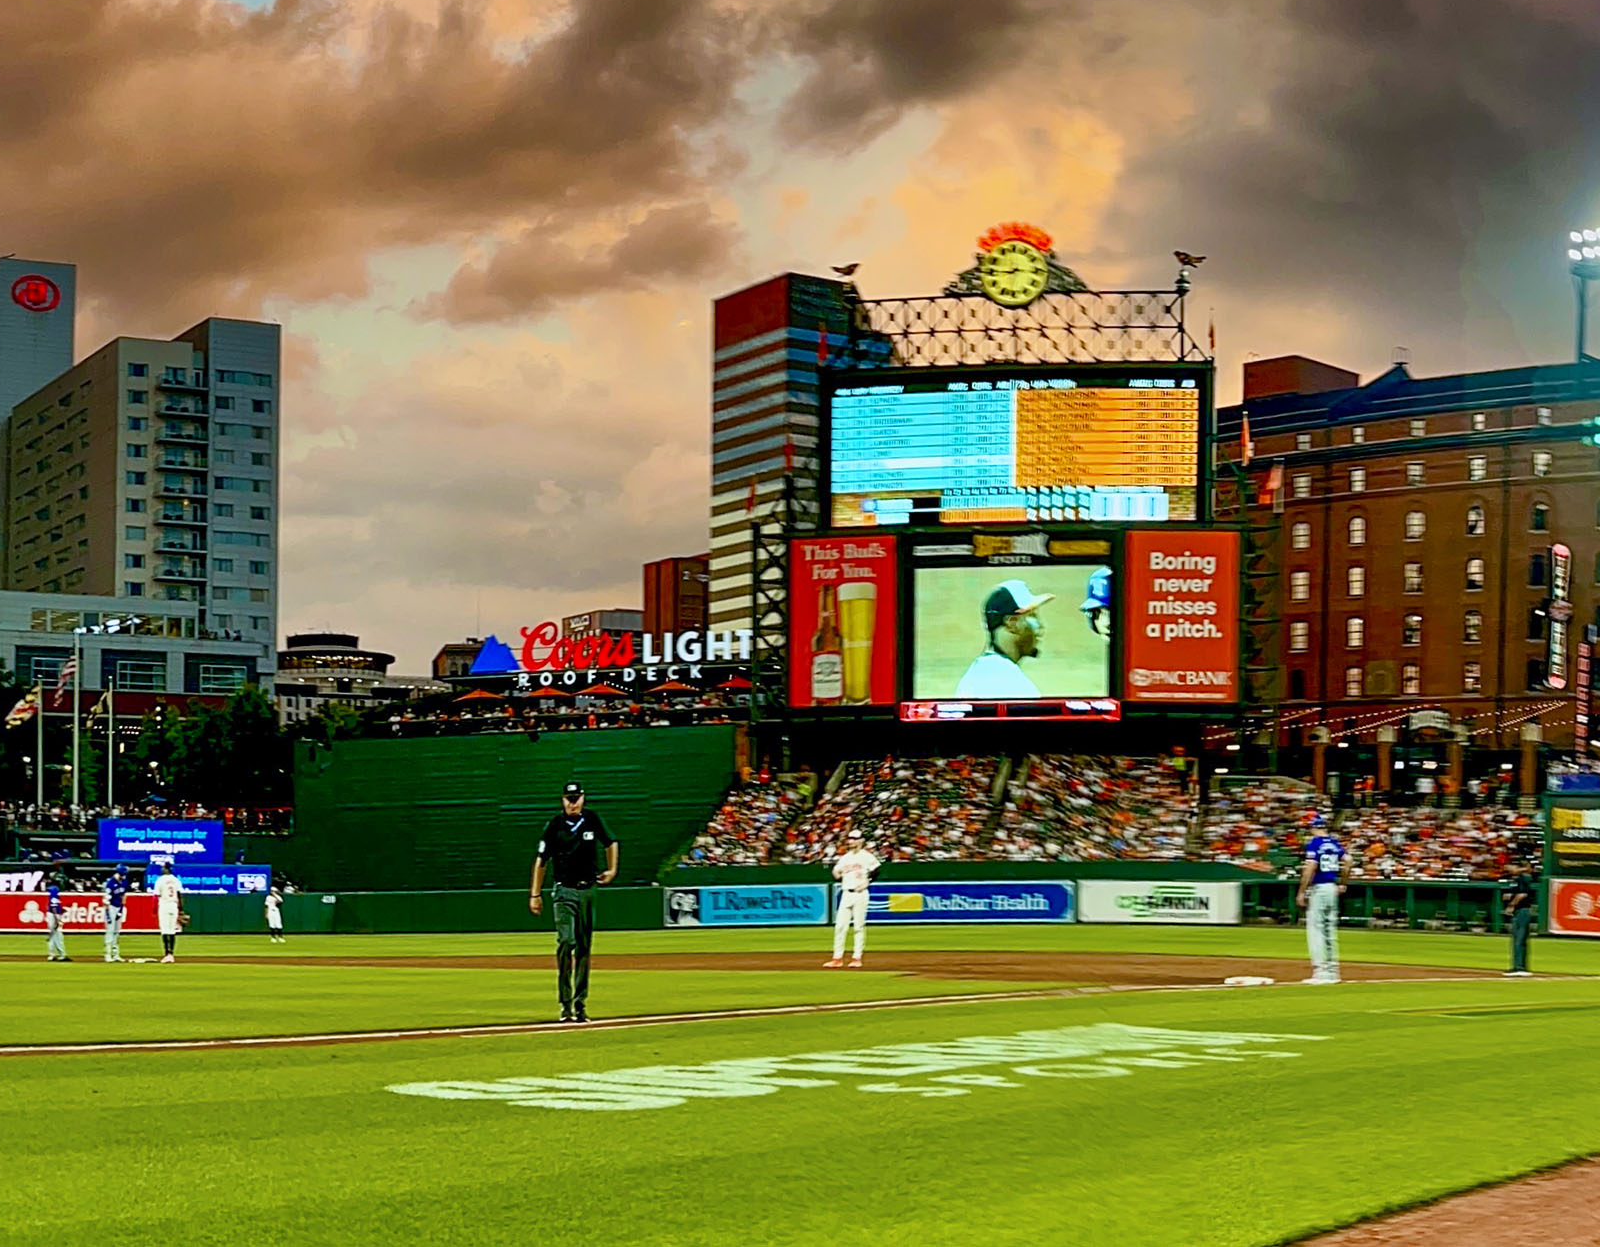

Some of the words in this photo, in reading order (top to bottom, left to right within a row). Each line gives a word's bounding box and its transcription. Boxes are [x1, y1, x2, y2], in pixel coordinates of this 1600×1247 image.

[803, 544, 839, 561] This
[844, 543, 886, 559] Bud's
[812, 564, 838, 580] For
[842, 563, 877, 579] You.
[1150, 552, 1216, 575] Boring
[1154, 578, 1212, 593] never
[1148, 596, 1217, 615] misses
[1146, 622, 1161, 638] a
[1164, 619, 1223, 642] pitch.
[520, 621, 637, 672] Coors
[642, 629, 753, 664] LIGHT
[518, 669, 598, 688] ROOF
[623, 664, 703, 681] DECK
[115, 828, 146, 841] Hitting
[147, 828, 172, 840] home
[173, 830, 193, 840] runs
[194, 828, 207, 840] for
[118, 840, 173, 853] hardworking
[174, 841, 207, 853] people.
[924, 893, 990, 911] MedStar
[991, 892, 1050, 910] Health
[859, 1047, 1302, 1098] SPORTS
